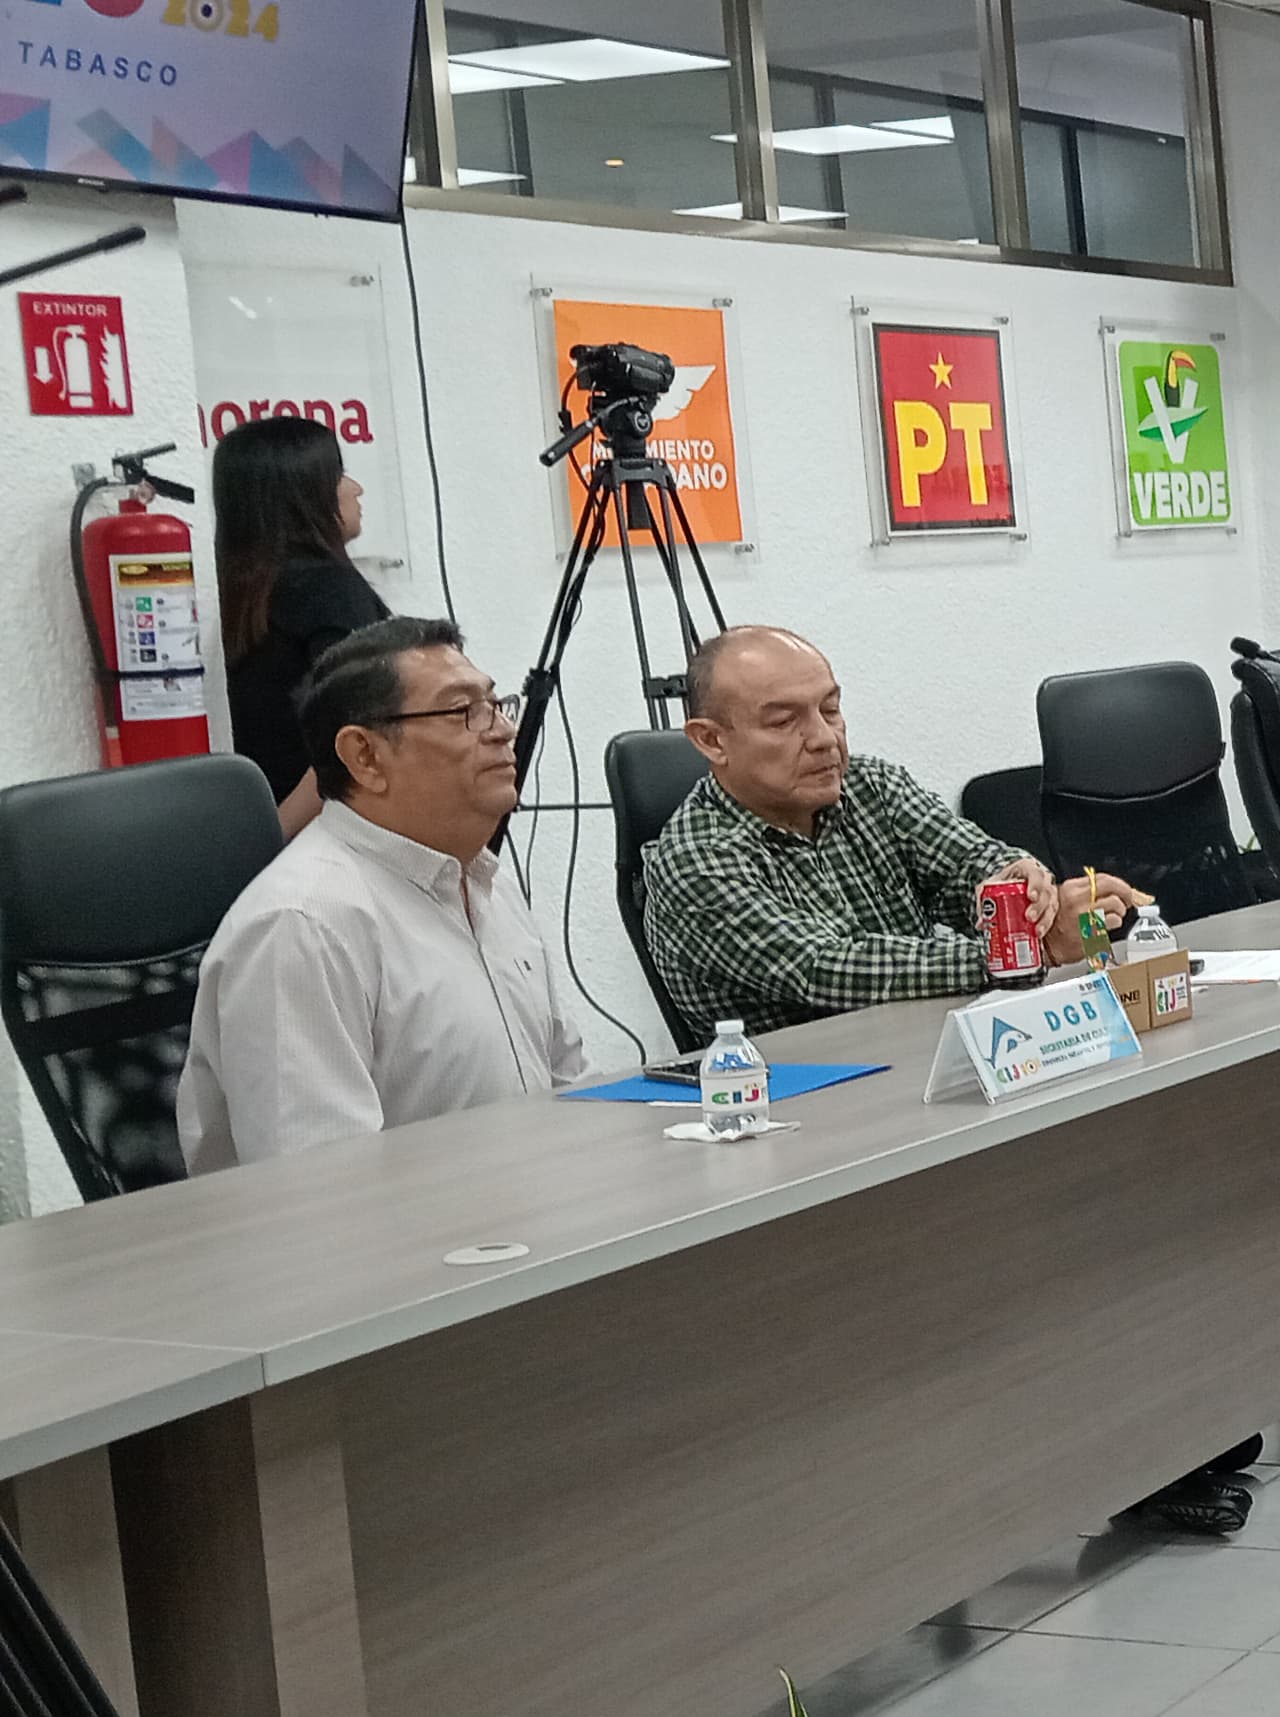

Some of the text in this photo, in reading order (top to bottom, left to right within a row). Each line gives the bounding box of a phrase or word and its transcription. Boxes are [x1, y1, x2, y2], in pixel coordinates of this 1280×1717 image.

[18, 41, 178, 87] TABASCO
[33, 301, 108, 317] EXTINTOR
[894, 401, 993, 507] PT
[1134, 472, 1229, 519] VERDE
[1044, 1000, 1098, 1032] DGB
